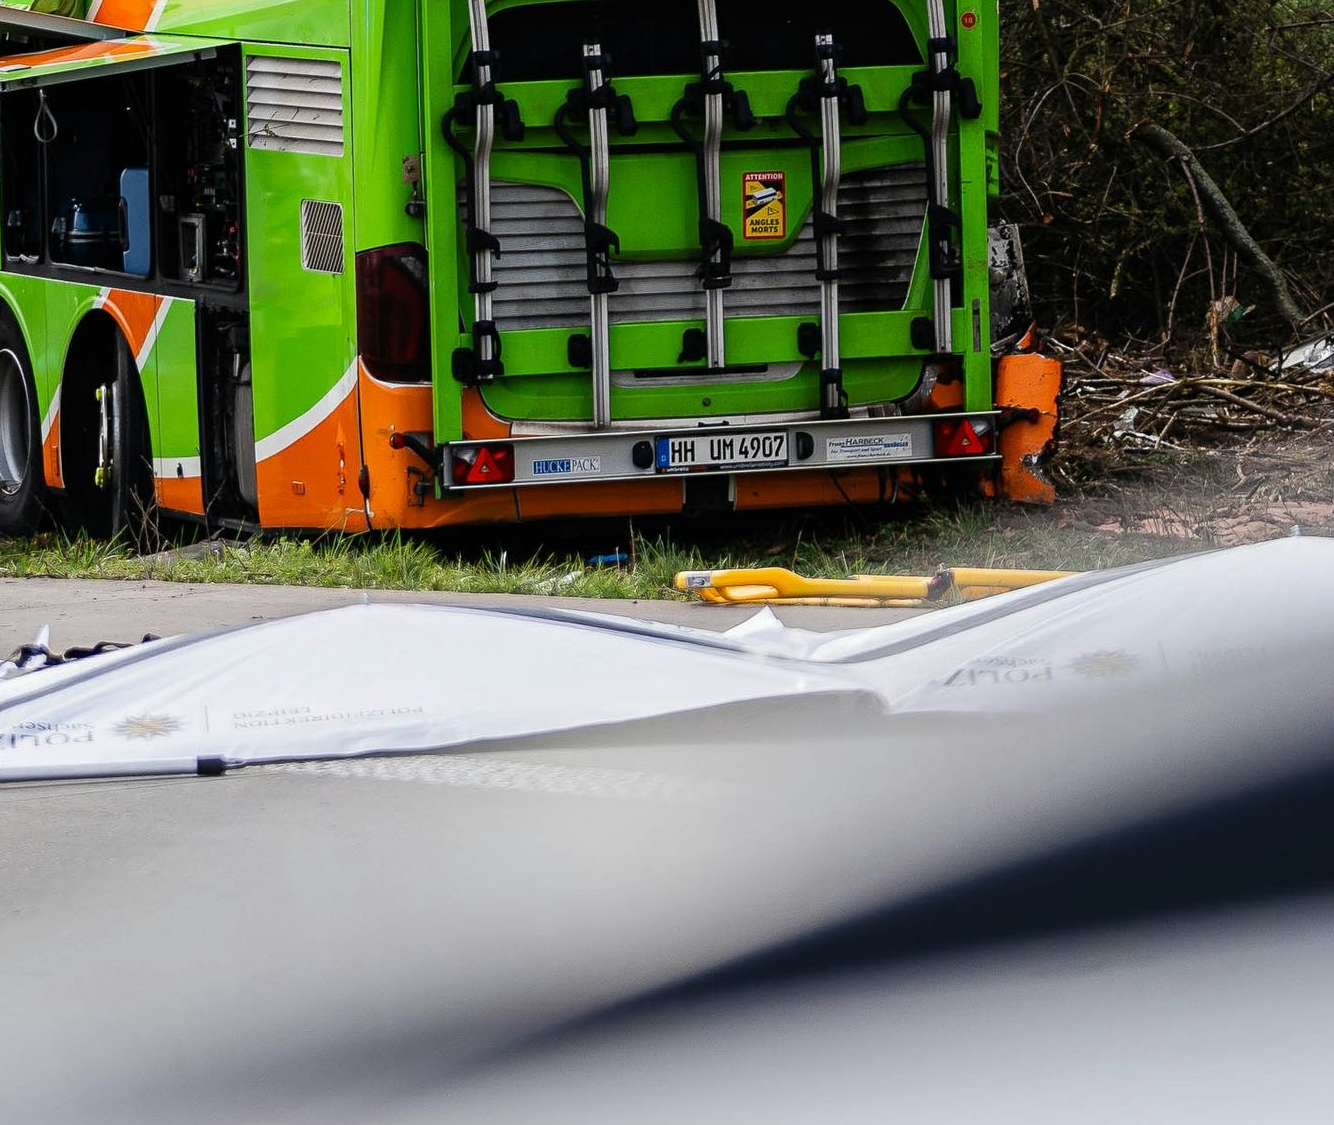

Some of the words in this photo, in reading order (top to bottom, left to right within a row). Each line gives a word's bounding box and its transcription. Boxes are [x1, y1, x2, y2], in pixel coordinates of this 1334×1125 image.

[671, 440, 695, 463] HH
[710, 438, 734, 460] UM
[739, 435, 785, 459] 4907
[845, 437, 884, 446] HARBECK
